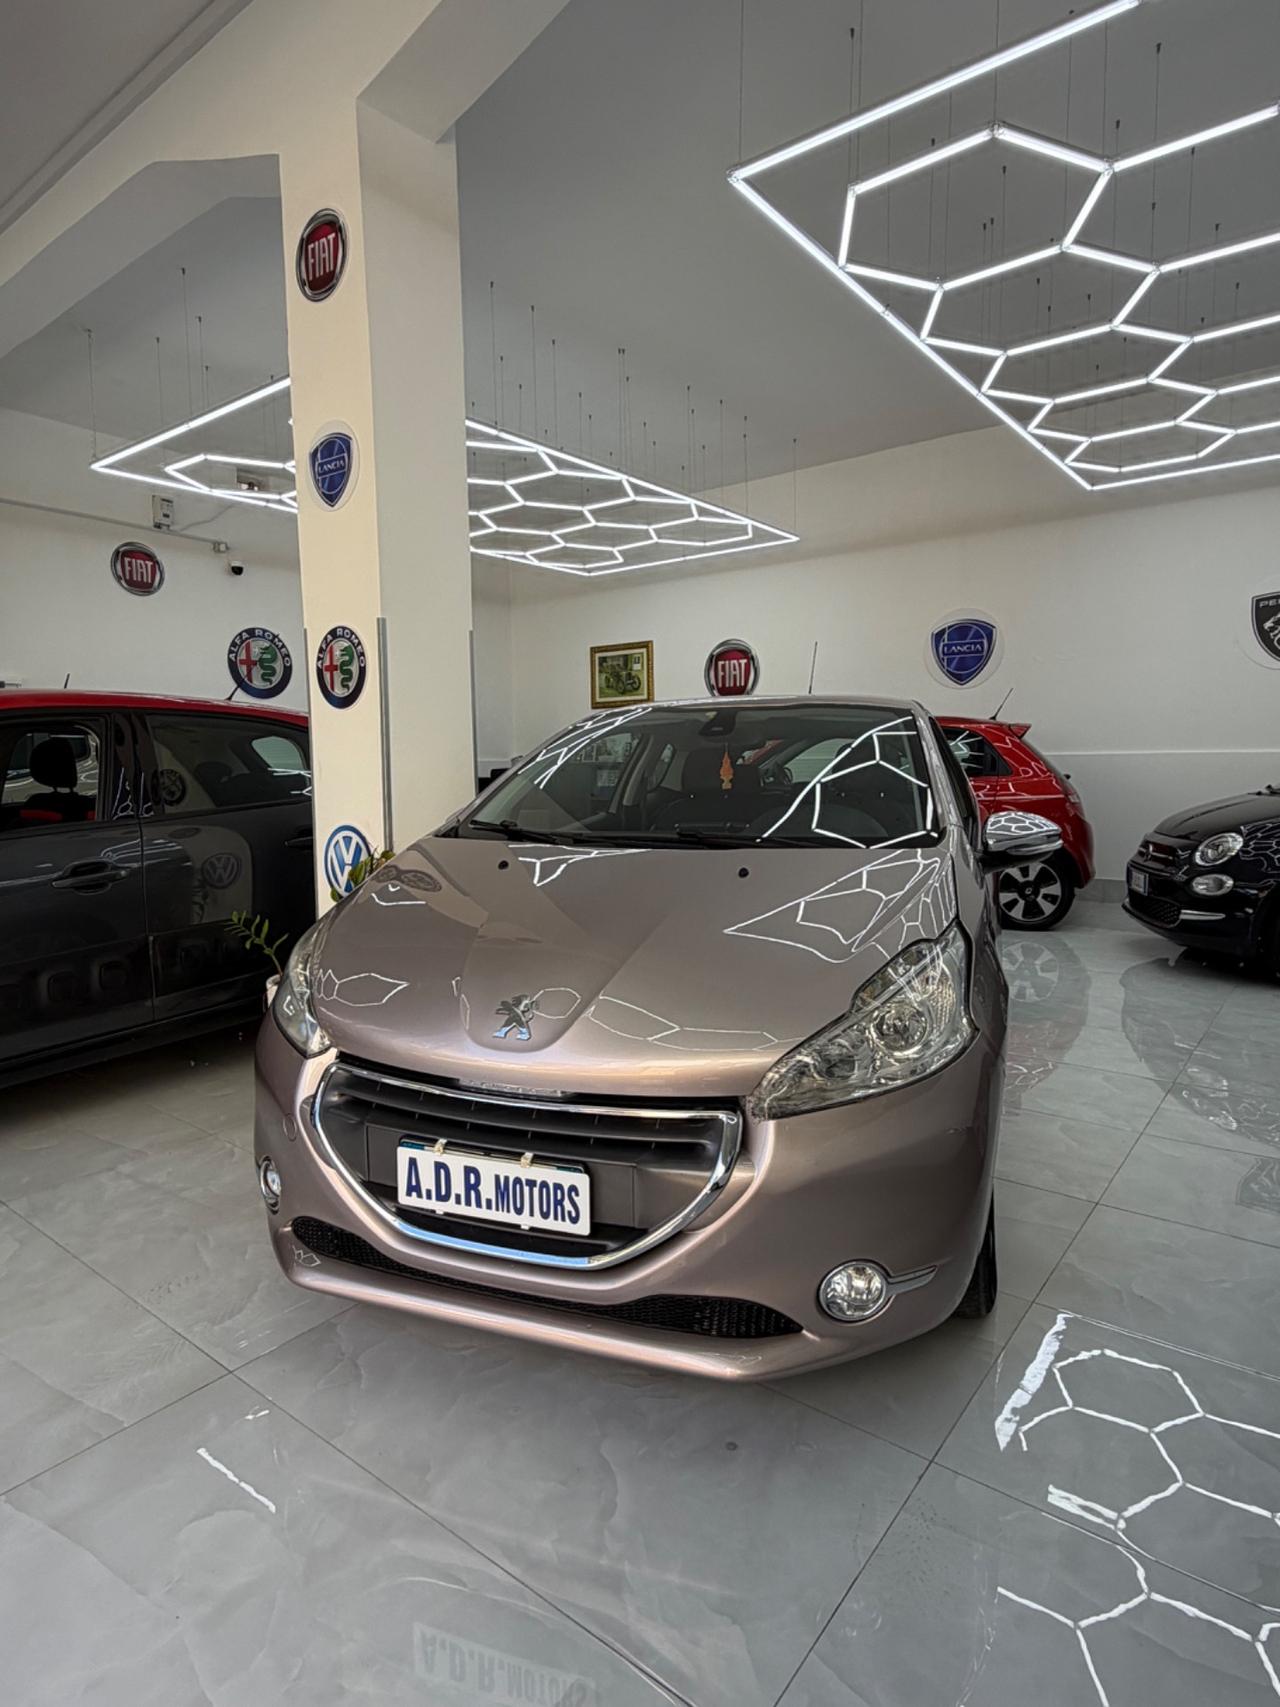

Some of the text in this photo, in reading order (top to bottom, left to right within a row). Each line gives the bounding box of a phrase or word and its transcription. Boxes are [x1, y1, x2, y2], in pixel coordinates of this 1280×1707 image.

[308, 232, 336, 281] FIAT
[319, 460, 345, 474] LANCIA
[124, 556, 153, 584] FIAT
[1259, 599, 1280, 608] PE
[229, 629, 291, 667] ALFA ROMEO
[316, 627, 366, 669] ALFA ROMEO
[943, 643, 982, 654] LANCIA
[717, 658, 747, 688] FIAT
